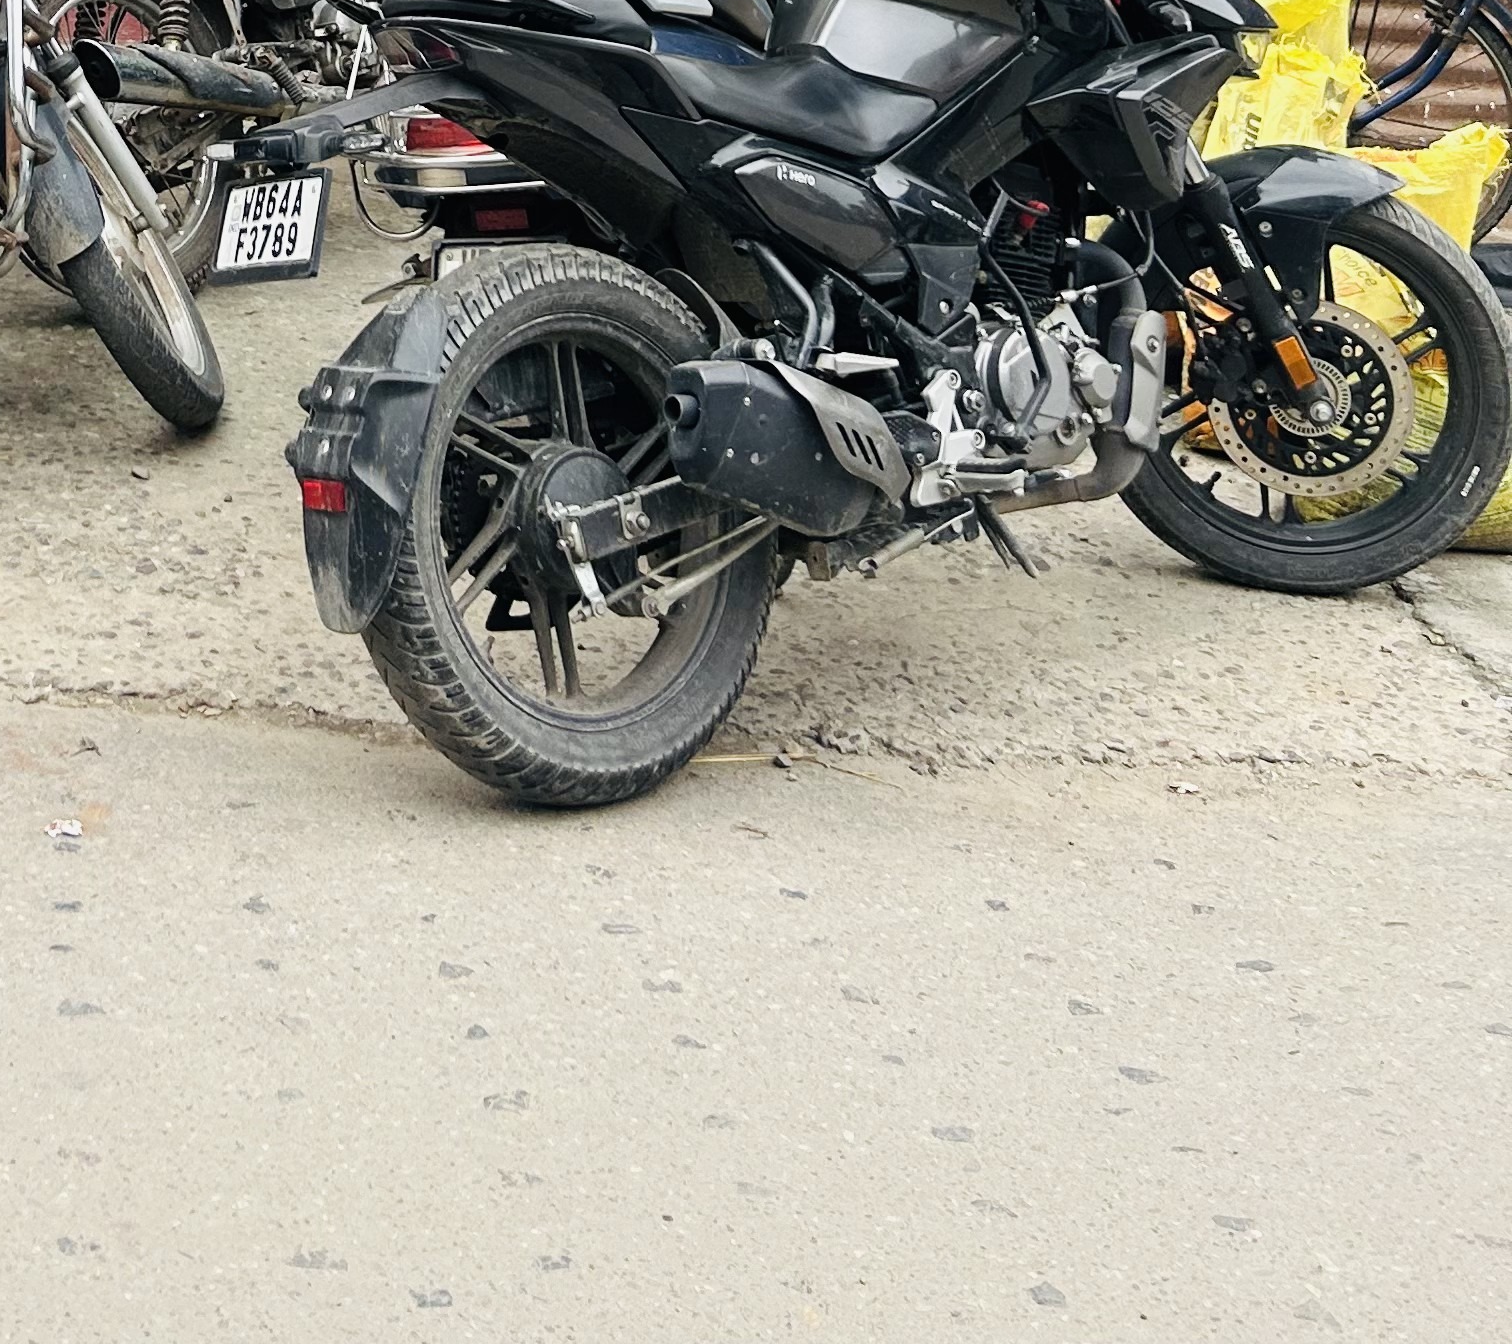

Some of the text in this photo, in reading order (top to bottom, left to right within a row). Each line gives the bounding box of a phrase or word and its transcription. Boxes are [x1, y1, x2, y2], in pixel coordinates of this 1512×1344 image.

[788, 169, 816, 187] Hero
[242, 179, 304, 223] WB64A
[234, 222, 299, 263] F3789
[1218, 223, 1255, 269] ABS
